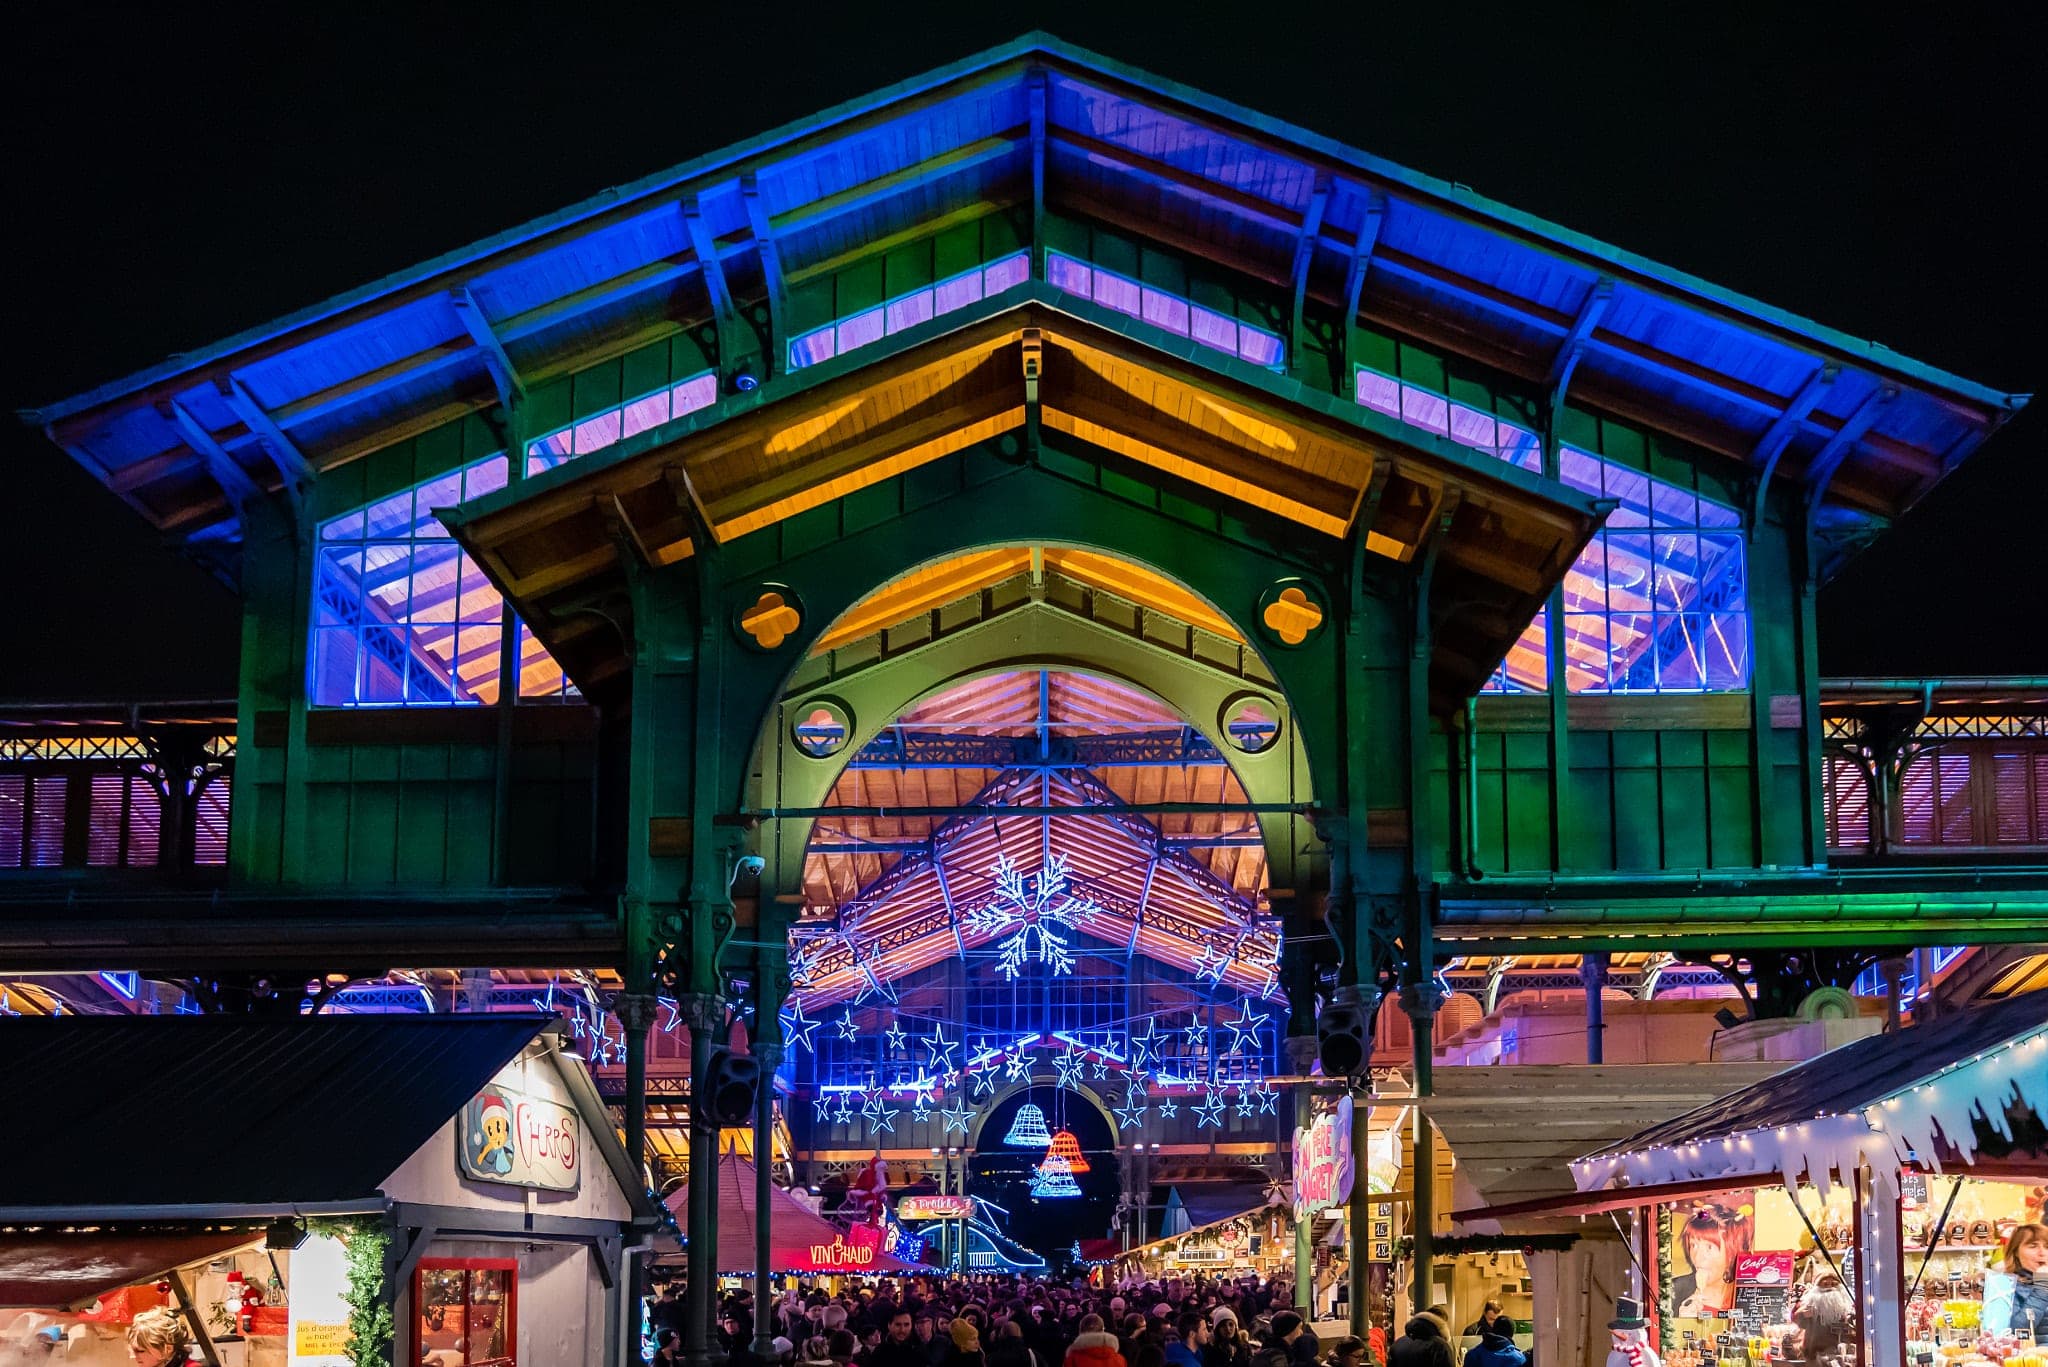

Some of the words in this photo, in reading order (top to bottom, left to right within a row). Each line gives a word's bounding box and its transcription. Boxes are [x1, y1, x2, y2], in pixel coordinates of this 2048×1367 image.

[810, 1246, 832, 1264] VIN
[832, 1243, 873, 1265] CHAUD
[1740, 1256, 1768, 1271] Café
